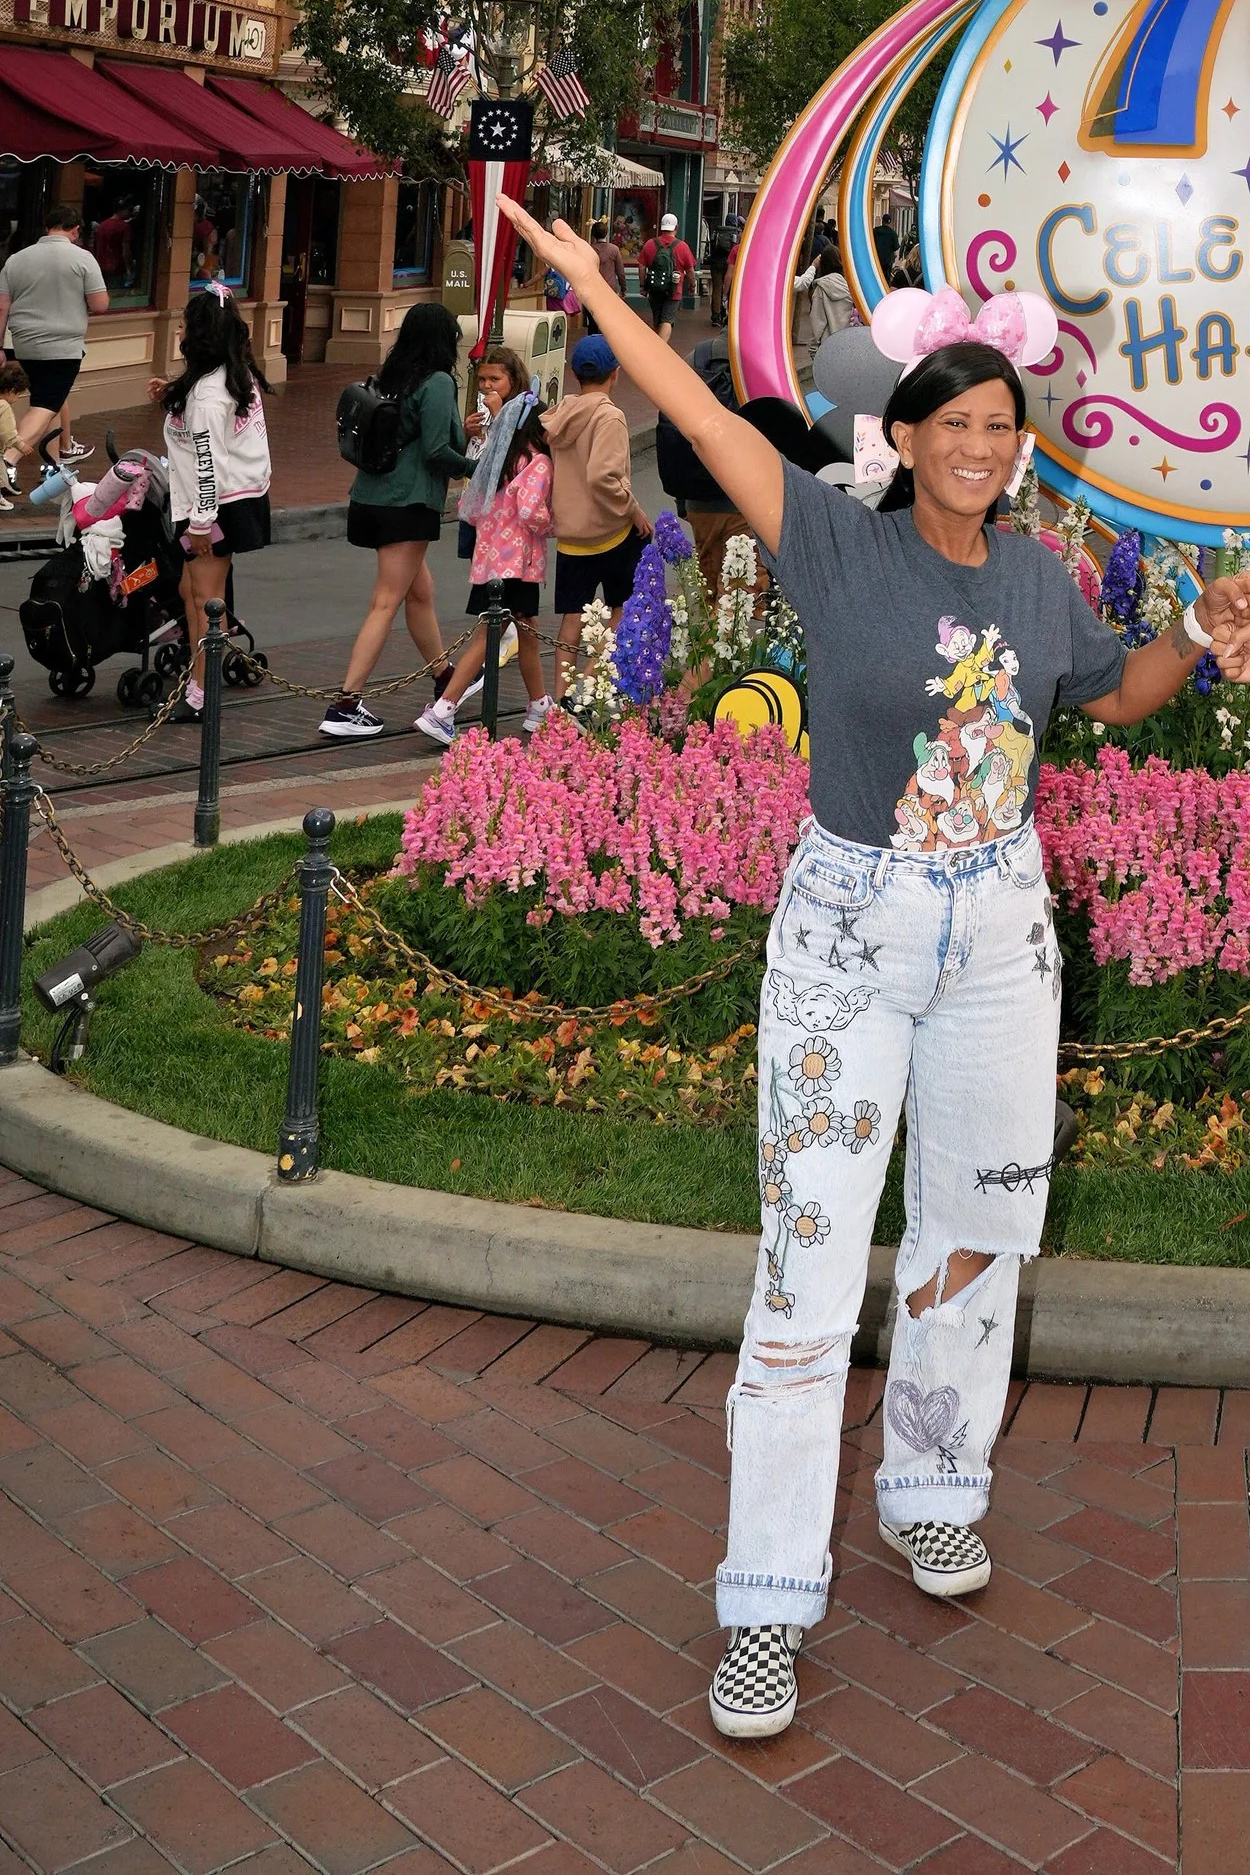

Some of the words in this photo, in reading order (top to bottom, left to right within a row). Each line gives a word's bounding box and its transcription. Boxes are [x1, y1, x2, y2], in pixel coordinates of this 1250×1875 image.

[445, 280, 470, 288] MAIL
[450, 270, 468, 278] U.S.
[192, 429, 215, 473] MICKEY
[198, 474, 217, 514] MOUSE
